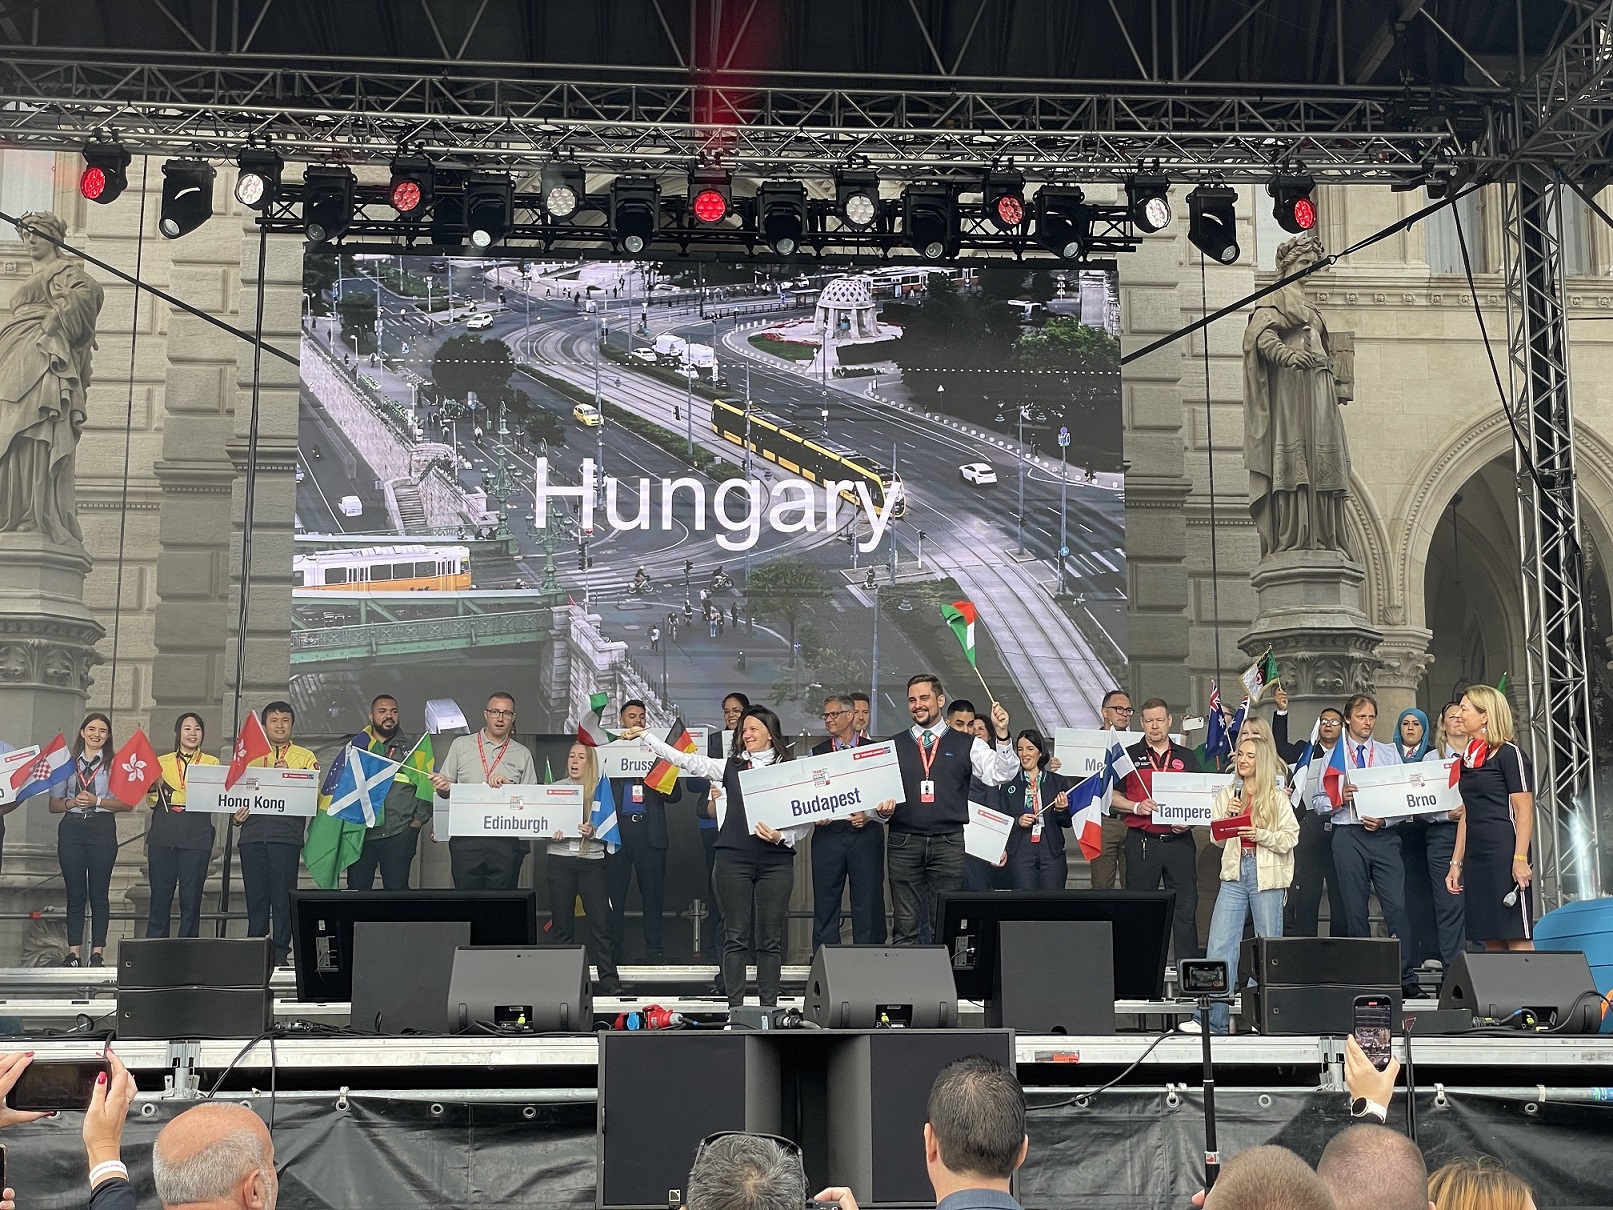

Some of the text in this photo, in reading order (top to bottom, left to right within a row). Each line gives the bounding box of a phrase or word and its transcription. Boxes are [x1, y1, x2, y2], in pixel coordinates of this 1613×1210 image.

[535, 456, 902, 553] Hungary
[218, 794, 285, 812] Hong Kong
[790, 787, 862, 817] Budapest
[1406, 794, 1437, 808] Brno
[1158, 803, 1212, 821] Tampere
[483, 815, 548, 833] Edinburgh
